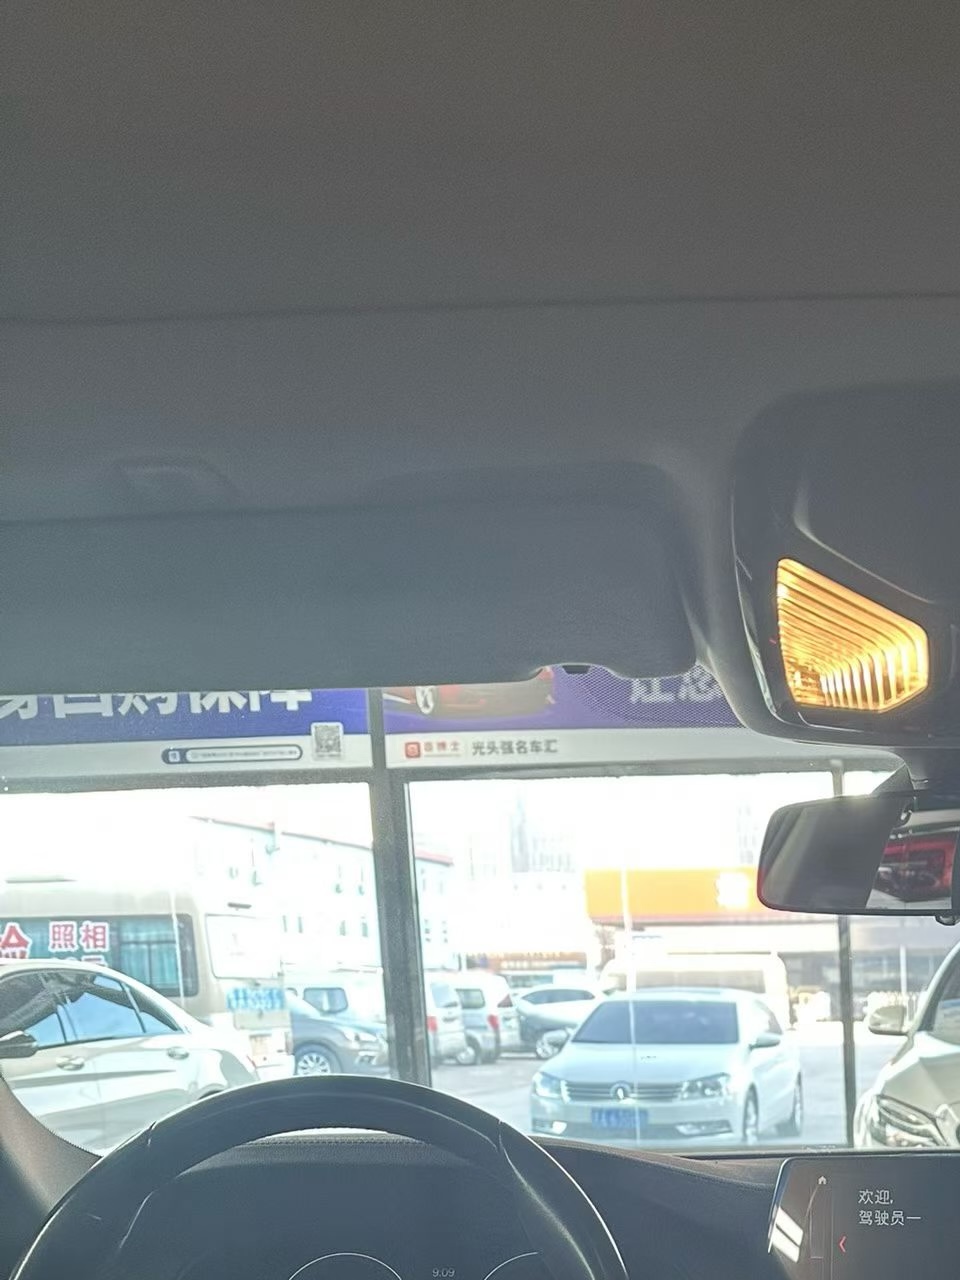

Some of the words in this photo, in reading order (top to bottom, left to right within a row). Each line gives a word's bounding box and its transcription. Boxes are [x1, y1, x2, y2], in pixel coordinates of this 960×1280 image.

[471, 739, 558, 756] 光头强名车汇
[50, 921, 109, 951] 照相
[858, 1209, 922, 1226] 驾驶员一
